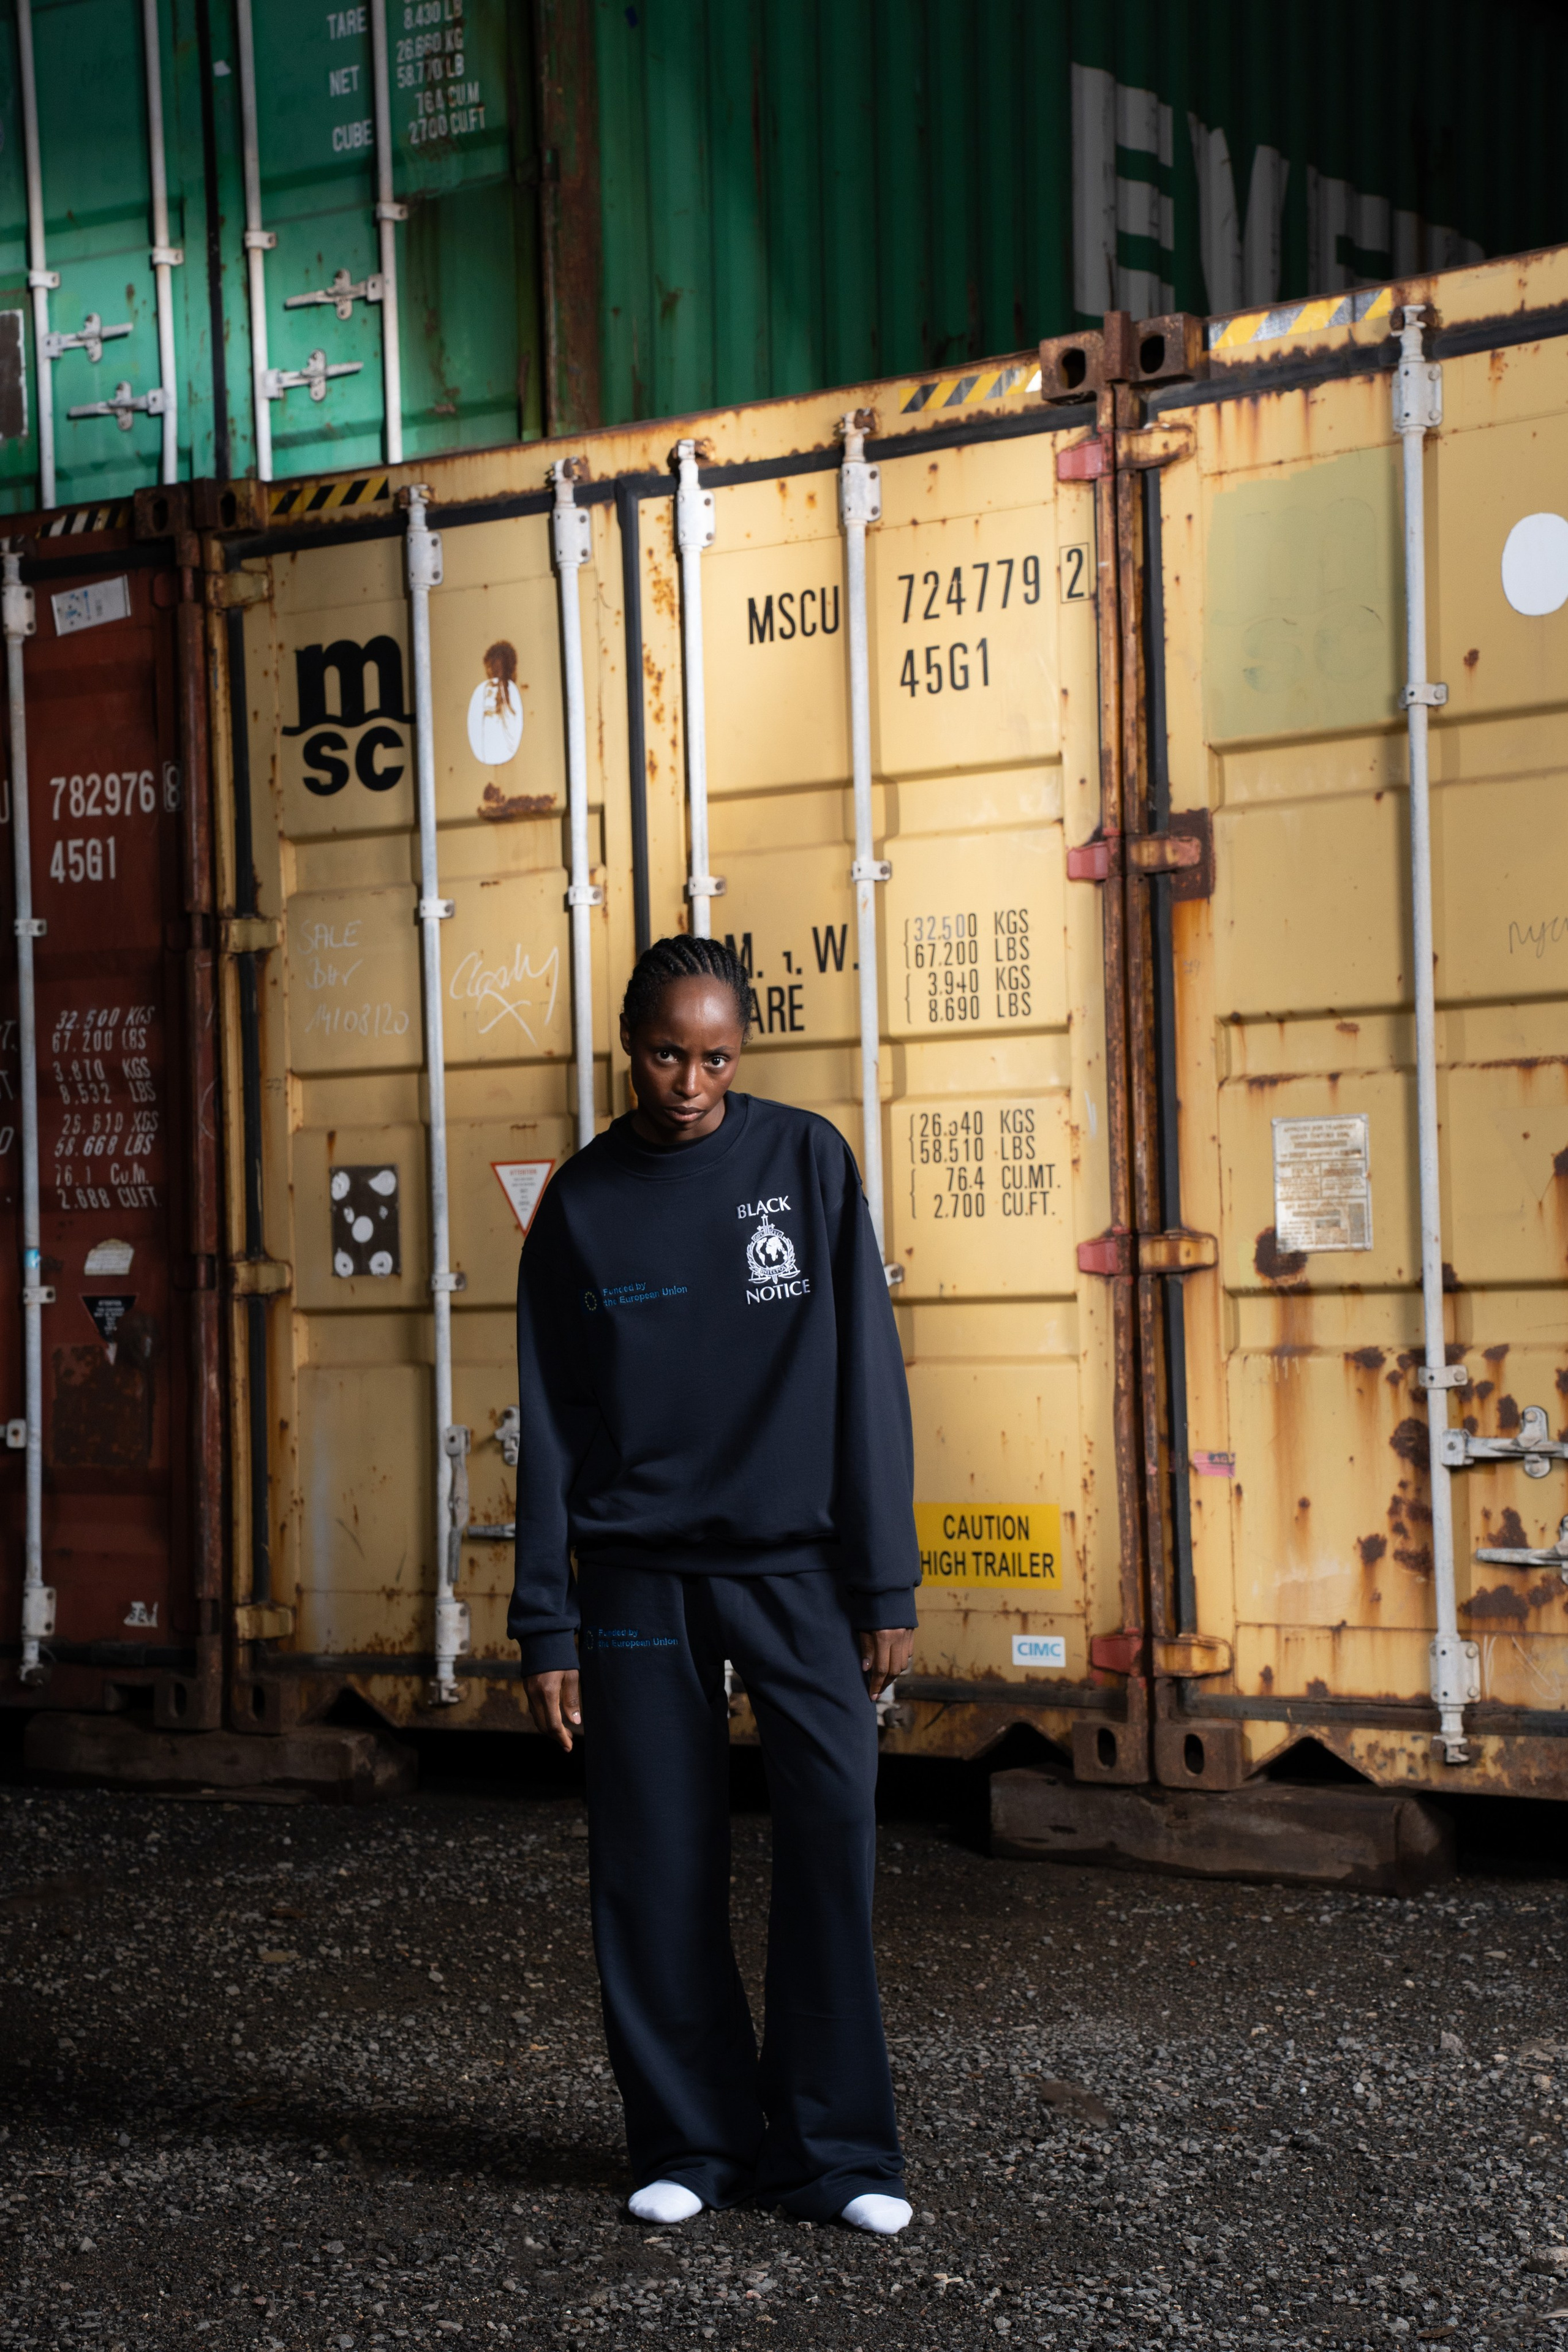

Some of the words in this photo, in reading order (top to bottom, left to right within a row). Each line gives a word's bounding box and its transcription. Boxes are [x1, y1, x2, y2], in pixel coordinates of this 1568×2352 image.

[327, 6, 368, 40] TARE
[445, 27, 464, 52] KG
[447, 53, 465, 78] LB
[329, 64, 360, 97] NET
[332, 119, 374, 152] CUBE
[747, 584, 839, 645] MSCU
[897, 554, 1041, 624] 724779
[1066, 548, 1085, 600] 2
[900, 637, 990, 698] 45G1
[50, 769, 156, 821] 782976
[166, 765, 181, 809] 8
[50, 835, 116, 884] 45G1
[297, 919, 364, 955] SALE
[914, 913, 977, 941] 32.500
[995, 908, 1029, 935] KGS
[915, 939, 978, 969] 67.200
[995, 935, 1030, 962] LBS
[928, 968, 979, 997] 3.940
[996, 965, 1031, 992] KGS
[56, 1007, 121, 1030] 32.500
[748, 984, 805, 1035] ARE
[929, 995, 980, 1023] 8.690
[997, 991, 1032, 1018] LBS
[52, 1029, 113, 1054] 67.200
[122, 1027, 147, 1050] LBS
[53, 1058, 105, 1082] 3.870
[123, 1056, 151, 1080] KGS
[59, 1082, 112, 1105] 8.532
[129, 1080, 157, 1103] LBS
[1000, 1108, 1035, 1134] KGS
[55, 1134, 119, 1158] 58.668
[124, 1134, 155, 1156] LBS
[920, 1136, 984, 1164] 58.510
[1001, 1134, 1036, 1161] LBS
[946, 1166, 985, 1192] 76.4
[1001, 1163, 1061, 1190] CU.MT.
[737, 1196, 791, 1219] BLACK
[933, 1192, 985, 1219] 2.700
[1002, 1190, 1056, 1217] CU.FT.
[602, 1283, 635, 1296] Funded
[635, 1282, 646, 1291] by
[603, 1299, 617, 1308] the
[619, 1291, 660, 1304] European
[662, 1285, 688, 1296] Union
[746, 1279, 811, 1305] NOTICE
[943, 1514, 1030, 1541] CAUTION
[920, 1550, 967, 1577] HIGH
[971, 1551, 1056, 1579] TRAILER
[598, 1629, 627, 1637] Funded
[628, 1629, 639, 1638] by
[611, 1639, 651, 1649] European
[652, 1637, 679, 1646] Union
[1017, 1642, 1061, 1657] CIMC
